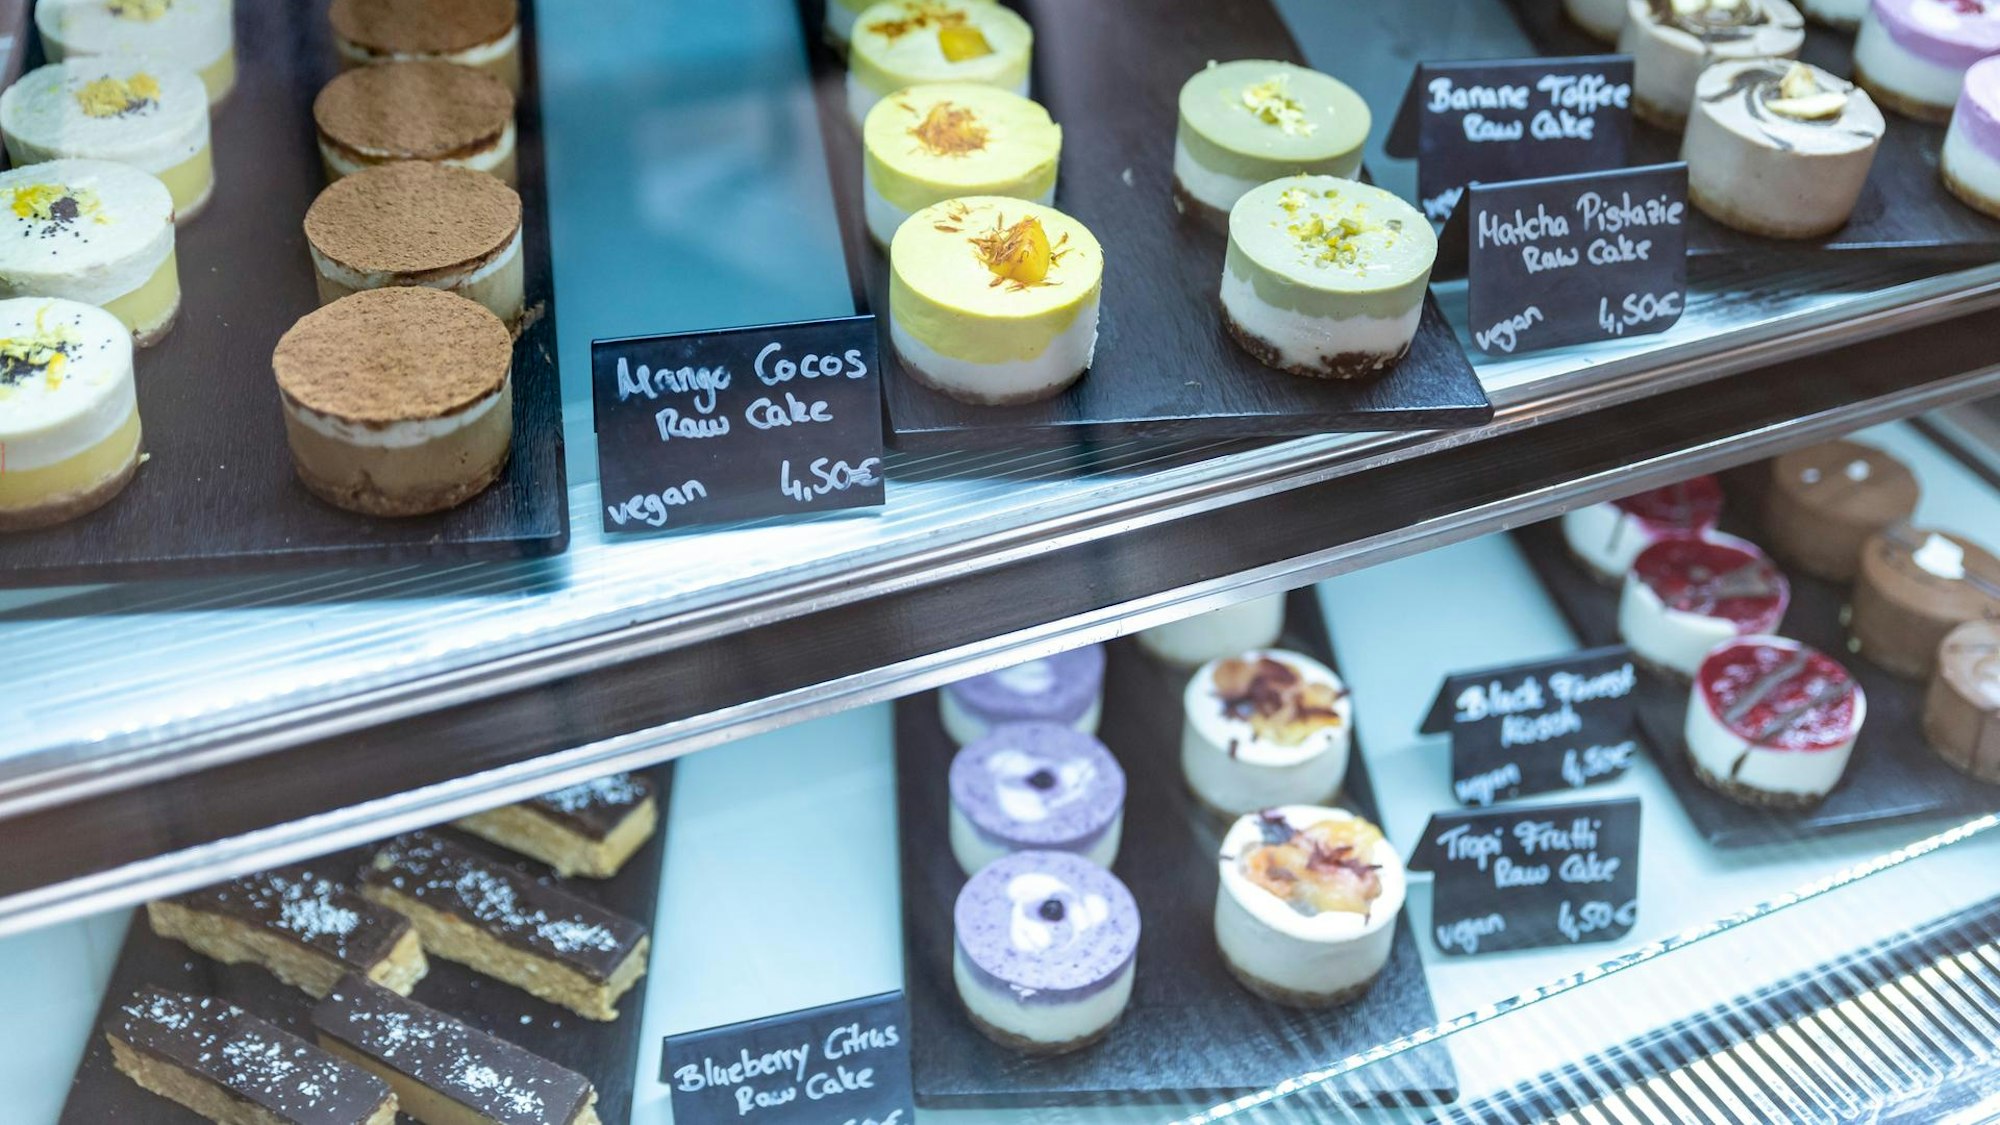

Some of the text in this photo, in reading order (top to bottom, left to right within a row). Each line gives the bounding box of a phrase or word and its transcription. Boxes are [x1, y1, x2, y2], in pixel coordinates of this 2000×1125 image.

[1428, 74, 1630, 114] Banane Toffee
[1463, 109, 1594, 141] Raw Cake
[1478, 191, 1684, 248] Matcha Pistazie
[1522, 235, 1651, 274] Raw Cake
[1476, 305, 1544, 352] vegan
[1599, 291, 1682, 335] 4,50€
[617, 342, 867, 413] Mango Cocos
[655, 392, 833, 441] Raw Cake
[781, 457, 880, 501] 4,50€
[608, 479, 707, 527] vegan
[1454, 676, 1546, 722] Black
[1455, 763, 1522, 807] vegan
[1436, 818, 1601, 871] Tropi Frutti
[1494, 851, 1621, 888] Raw Cake
[1436, 913, 1506, 954] vegan
[1558, 900, 1637, 942] 4,50€
[674, 1022, 899, 1092] Blueberry Citrus
[734, 1065, 874, 1116] Raw Cake
